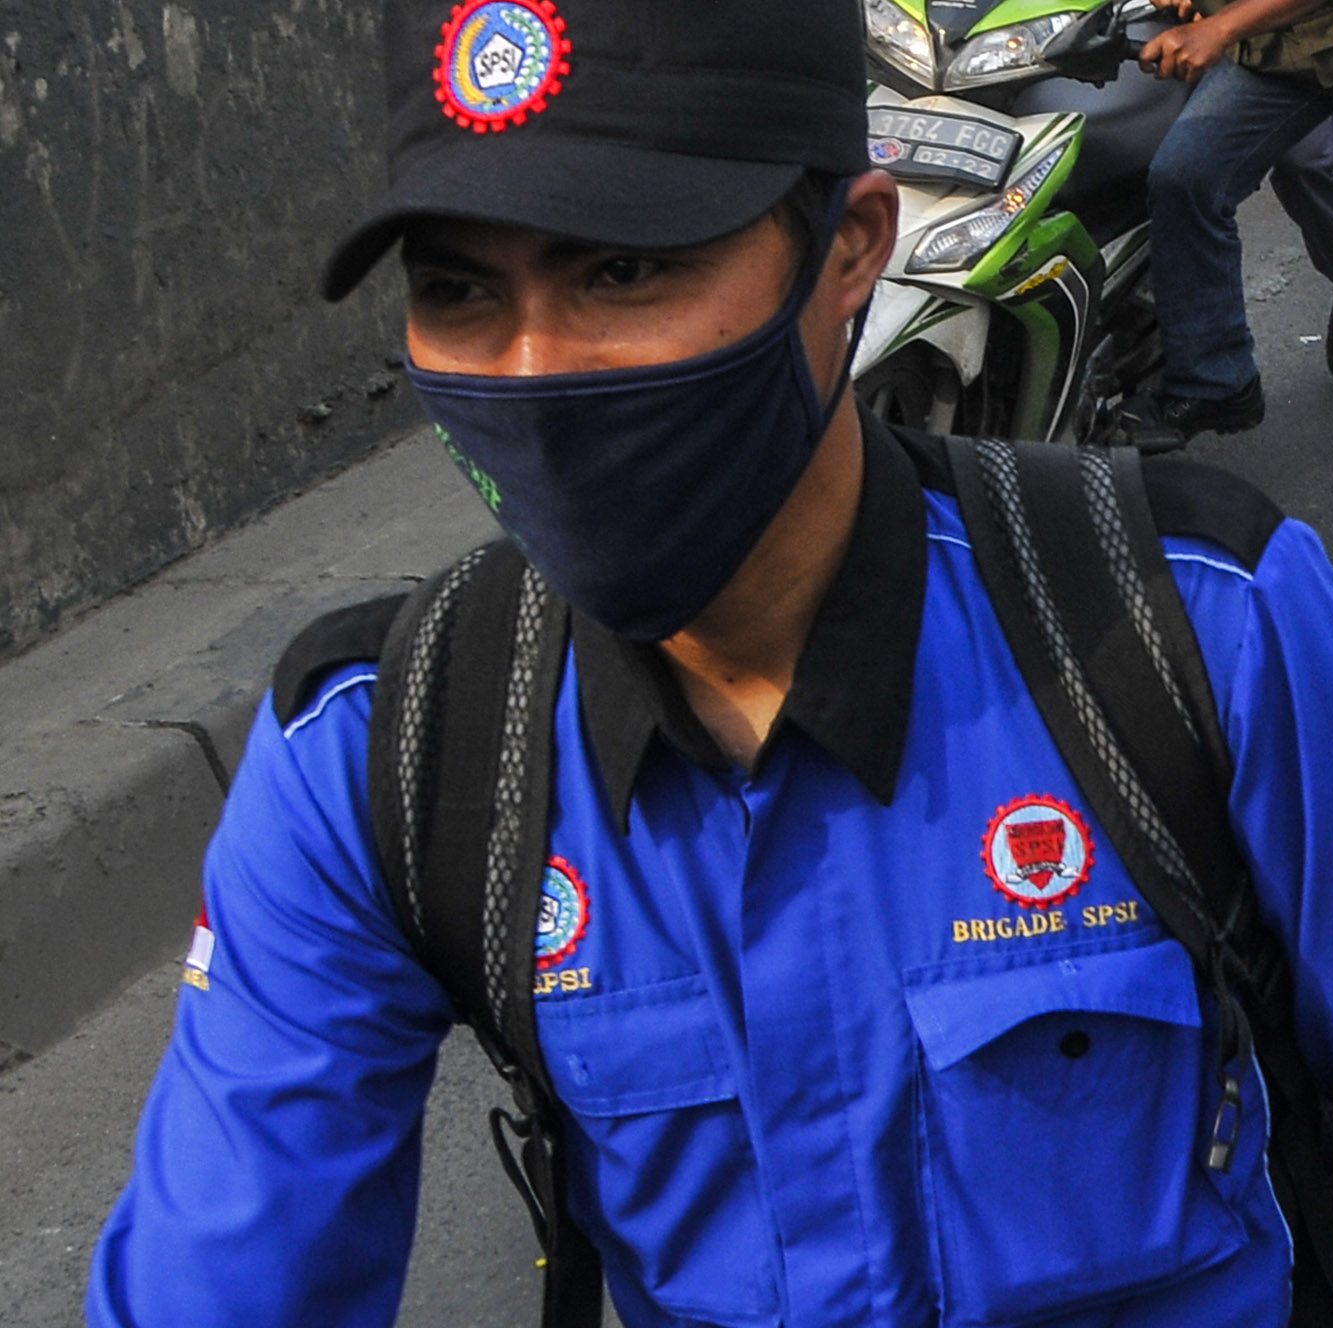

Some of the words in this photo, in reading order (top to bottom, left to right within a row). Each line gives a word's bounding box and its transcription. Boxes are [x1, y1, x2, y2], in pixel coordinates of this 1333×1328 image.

[479, 47, 517, 78] SPSI
[876, 115, 944, 142] 3764
[953, 911, 1065, 943] BRIGADE
[1082, 901, 1138, 927] SPSI
[533, 967, 592, 994] PSI
